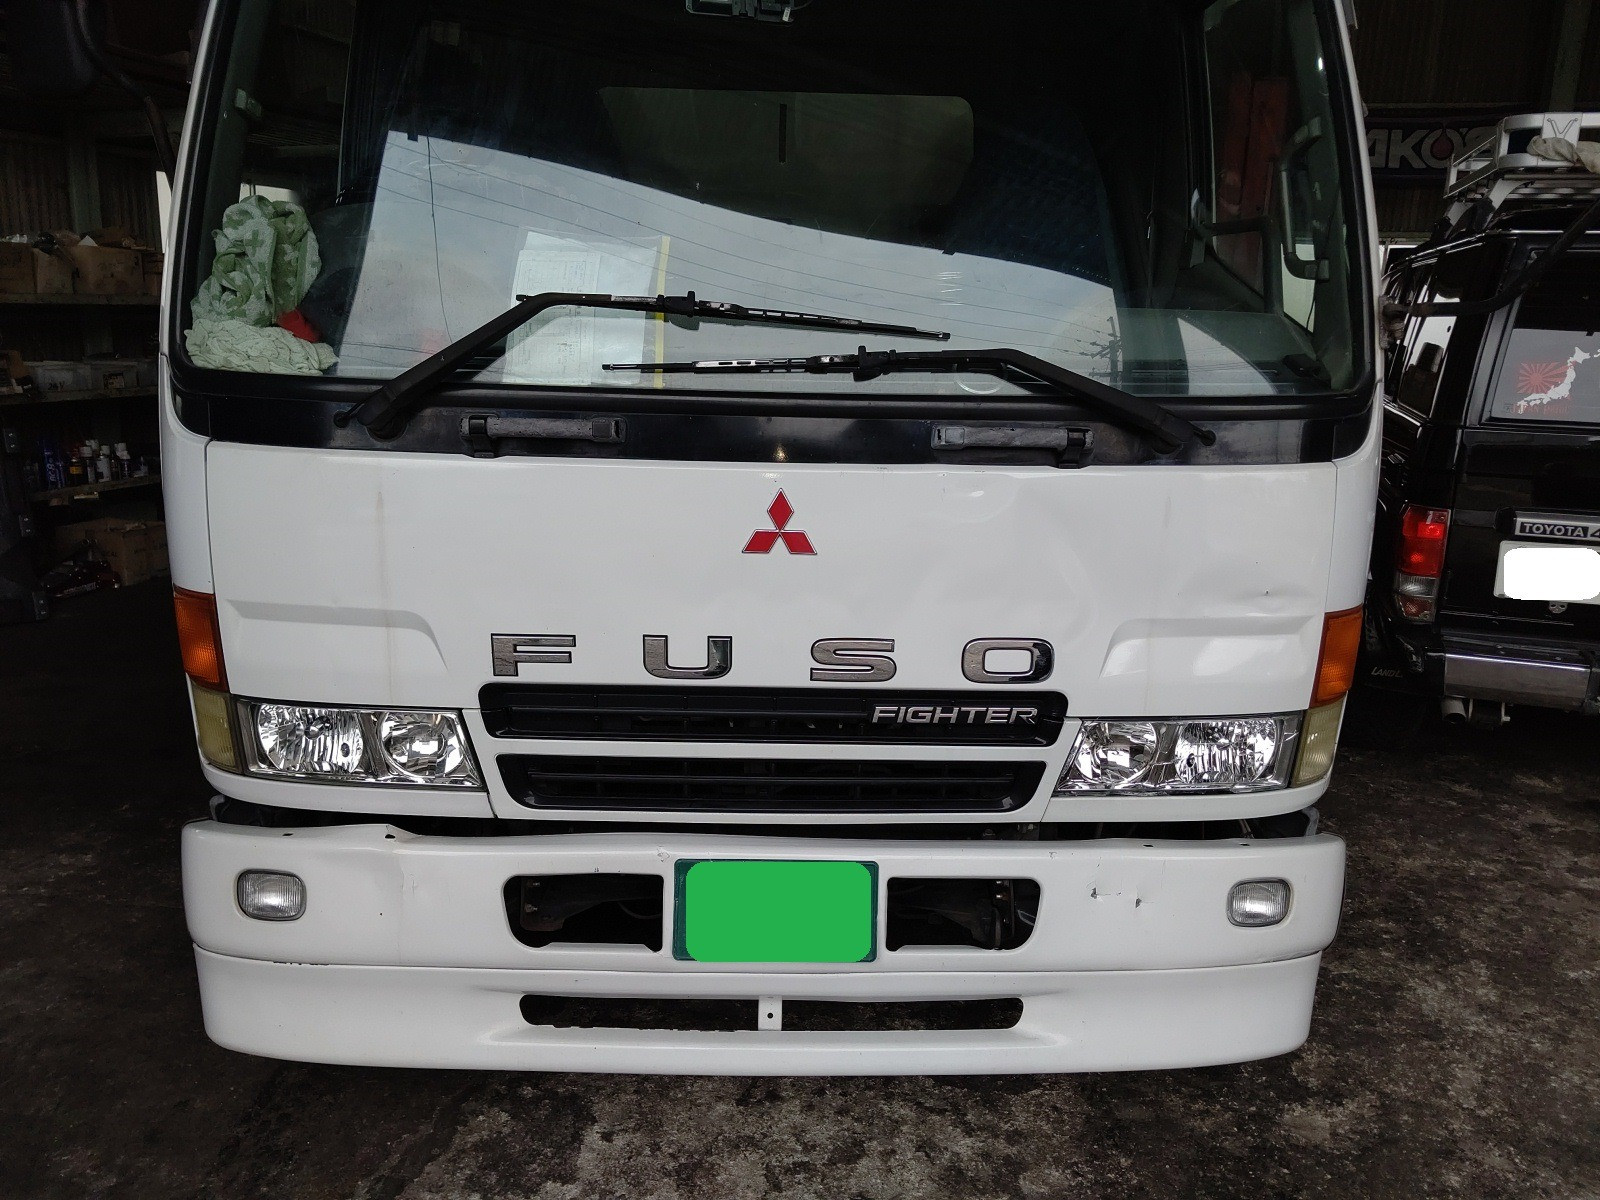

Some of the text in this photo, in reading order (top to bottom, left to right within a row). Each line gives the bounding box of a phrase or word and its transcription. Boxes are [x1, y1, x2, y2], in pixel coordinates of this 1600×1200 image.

[1523, 523, 1584, 537] TOYOTA
[491, 633, 1054, 684] FUSO
[871, 705, 1038, 725] FIGHTER
